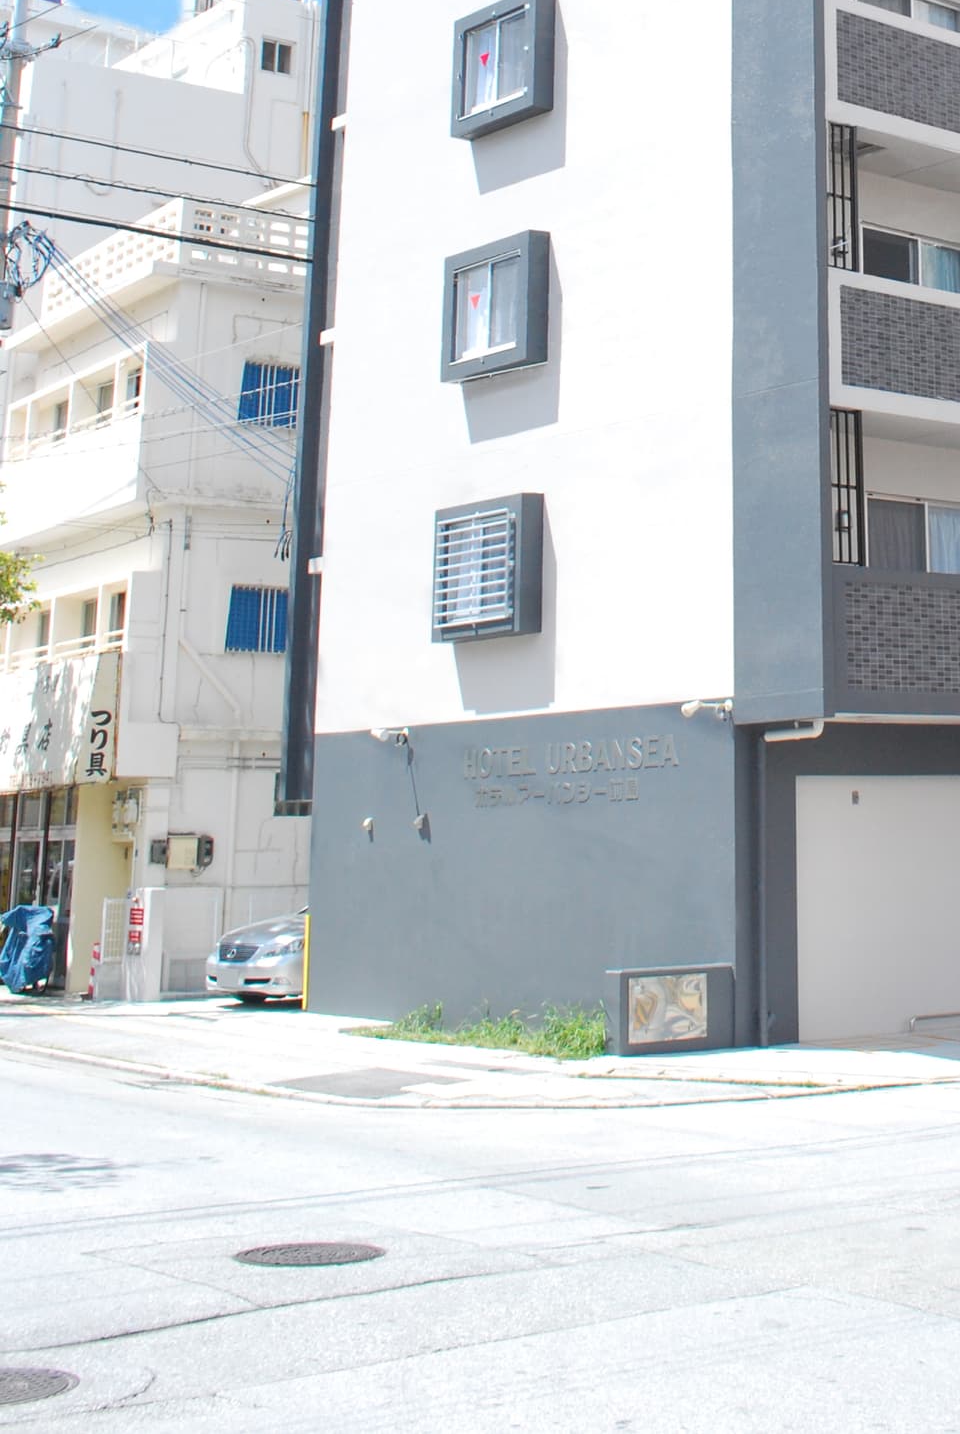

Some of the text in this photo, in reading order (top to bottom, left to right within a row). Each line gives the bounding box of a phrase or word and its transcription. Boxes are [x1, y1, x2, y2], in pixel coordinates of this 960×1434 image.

[85, 710, 112, 776] つり具
[463, 734, 680, 780] HOTEL URBANSEA
